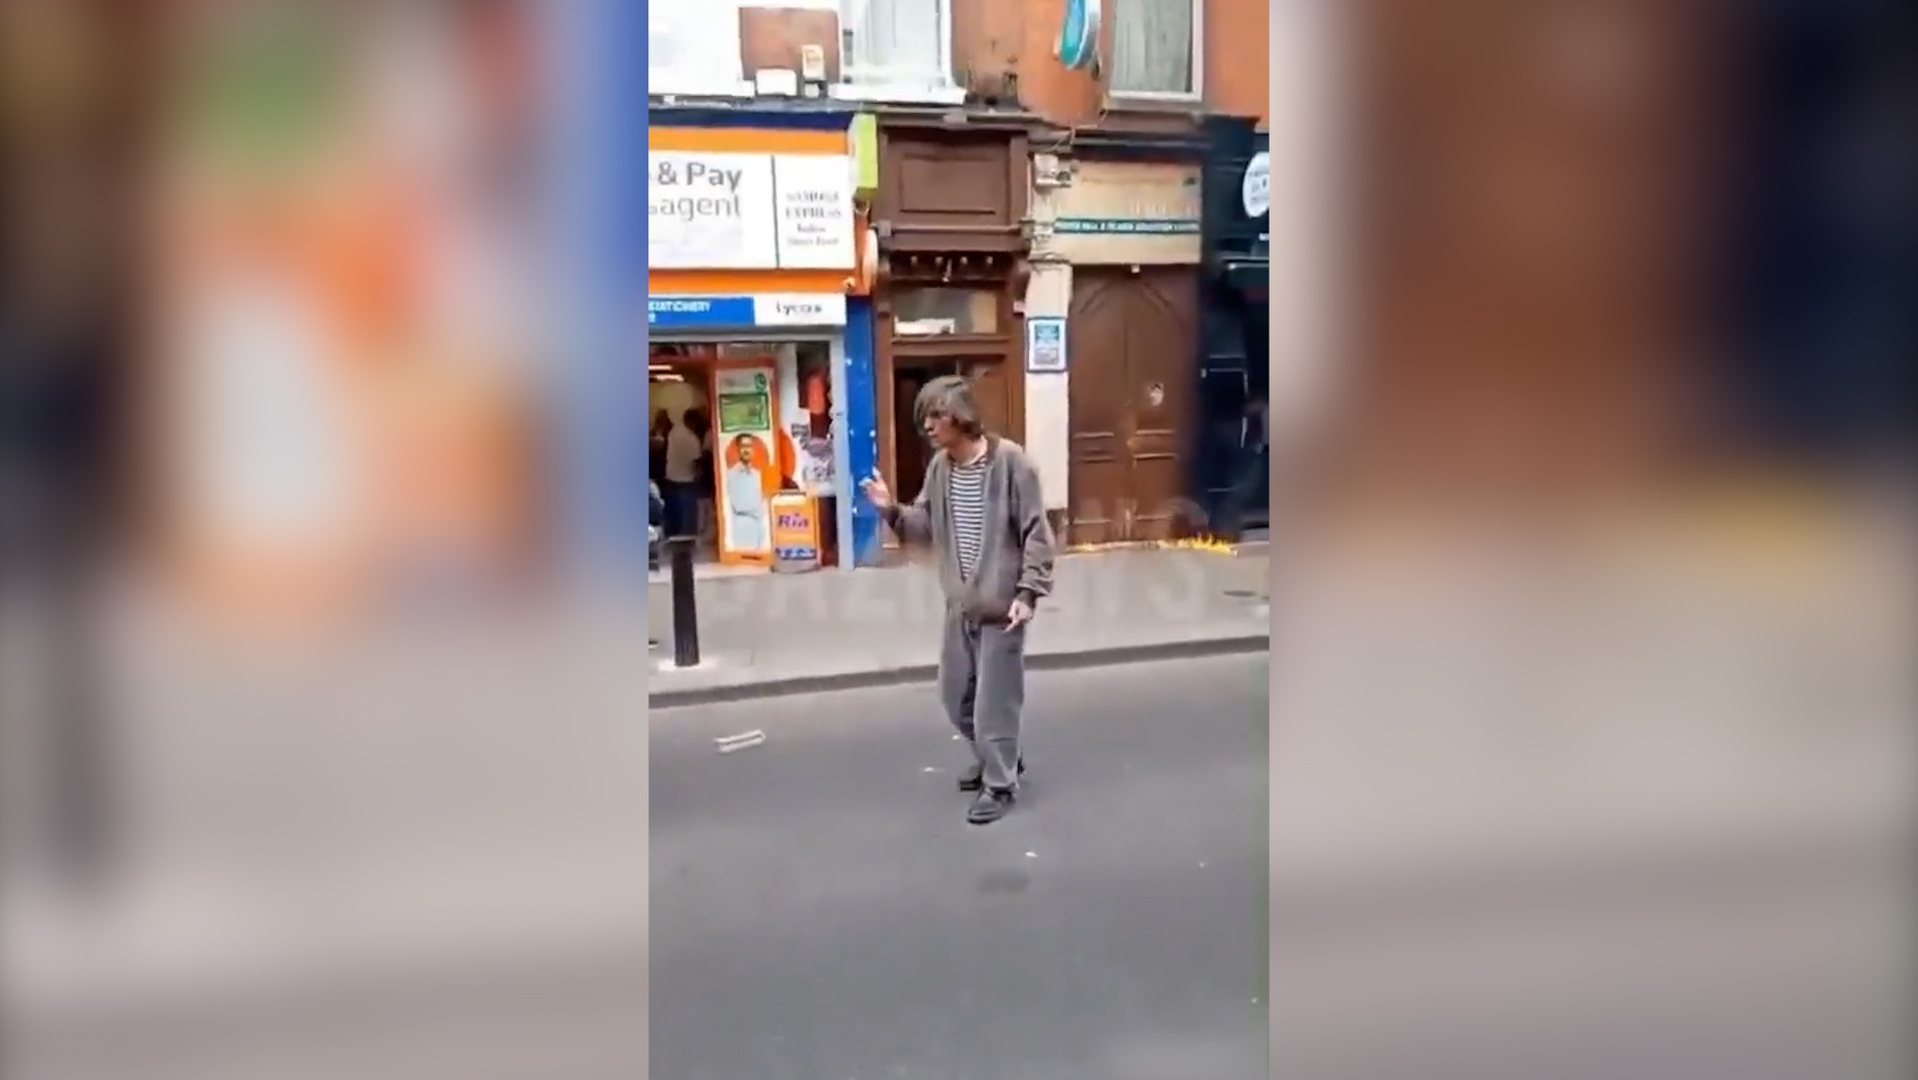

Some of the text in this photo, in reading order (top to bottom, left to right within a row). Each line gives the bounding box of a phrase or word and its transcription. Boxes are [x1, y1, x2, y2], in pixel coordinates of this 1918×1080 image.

[658, 161, 678, 185] &
[686, 162, 742, 193] Pay
[777, 512, 809, 528] Ria
